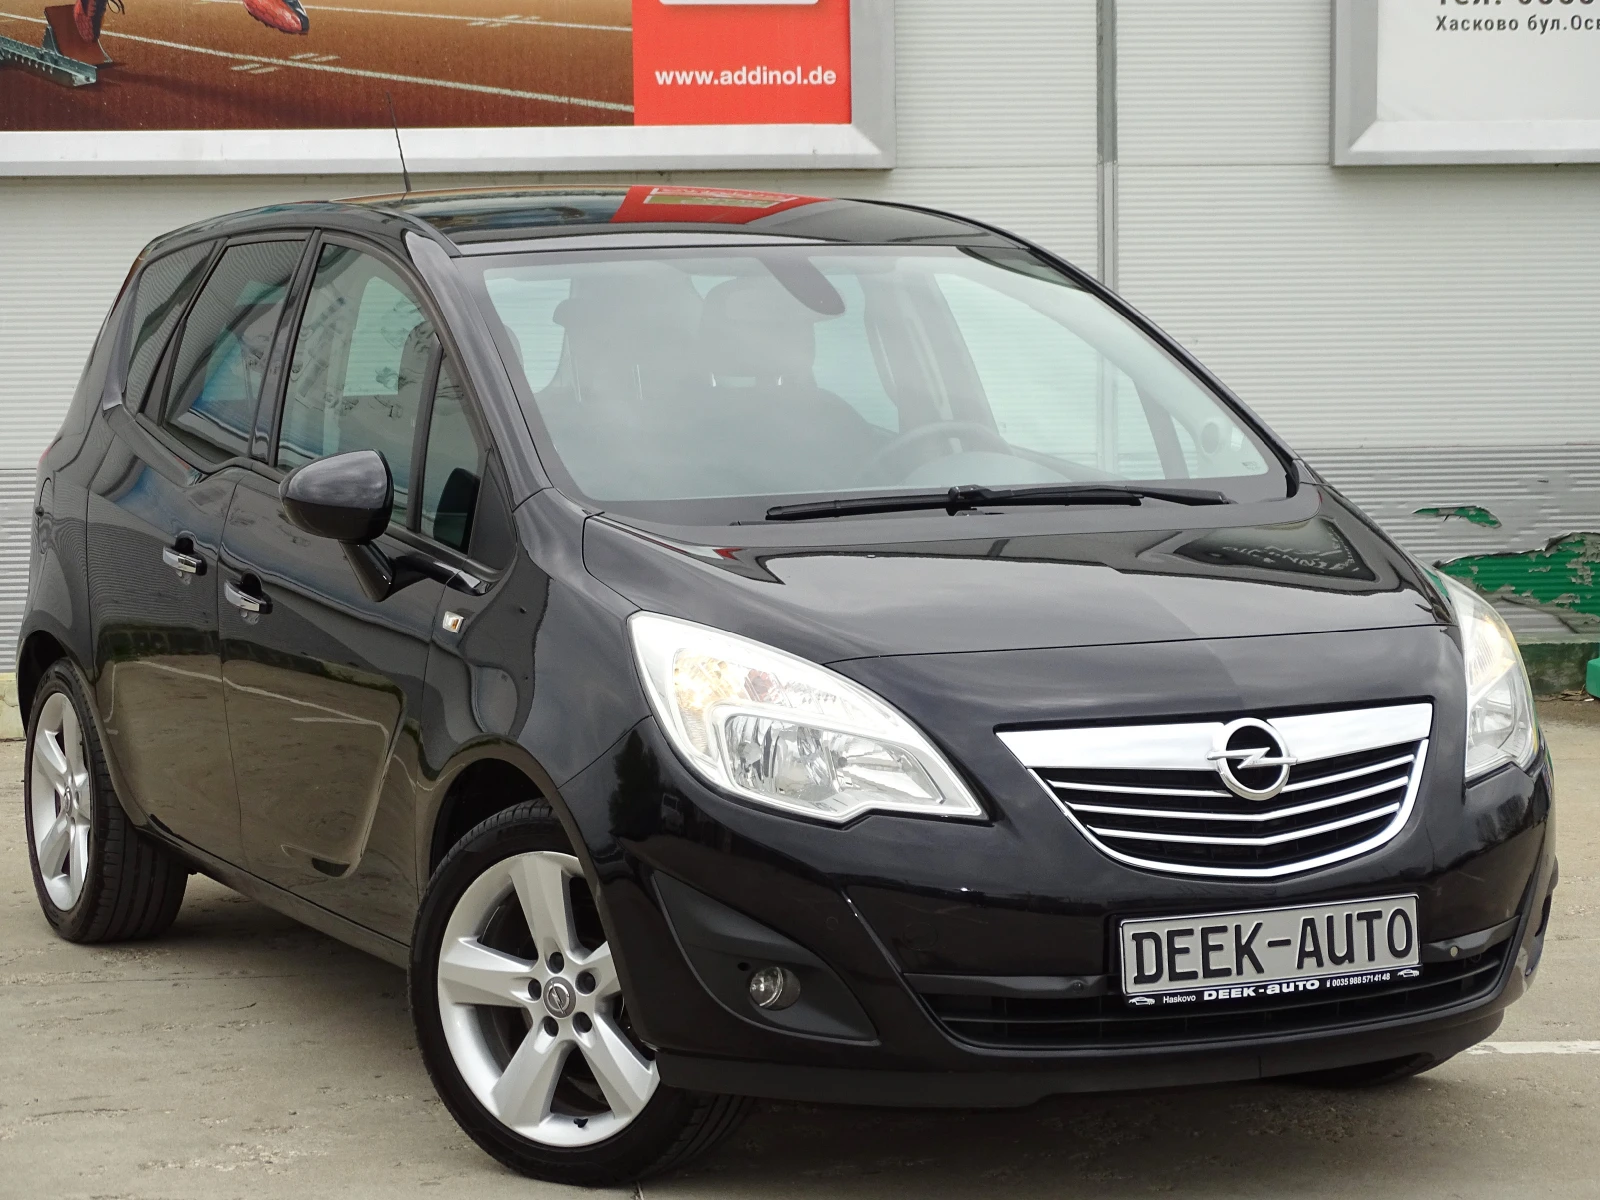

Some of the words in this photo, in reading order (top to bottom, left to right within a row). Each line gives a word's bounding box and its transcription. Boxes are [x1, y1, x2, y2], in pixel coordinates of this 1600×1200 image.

[1436, 15, 1519, 31] Хасково
[655, 66, 837, 85] www.addinol.de
[1131, 908, 1413, 985] DEEK-AUTO
[1163, 995, 1197, 1004] Haskovo
